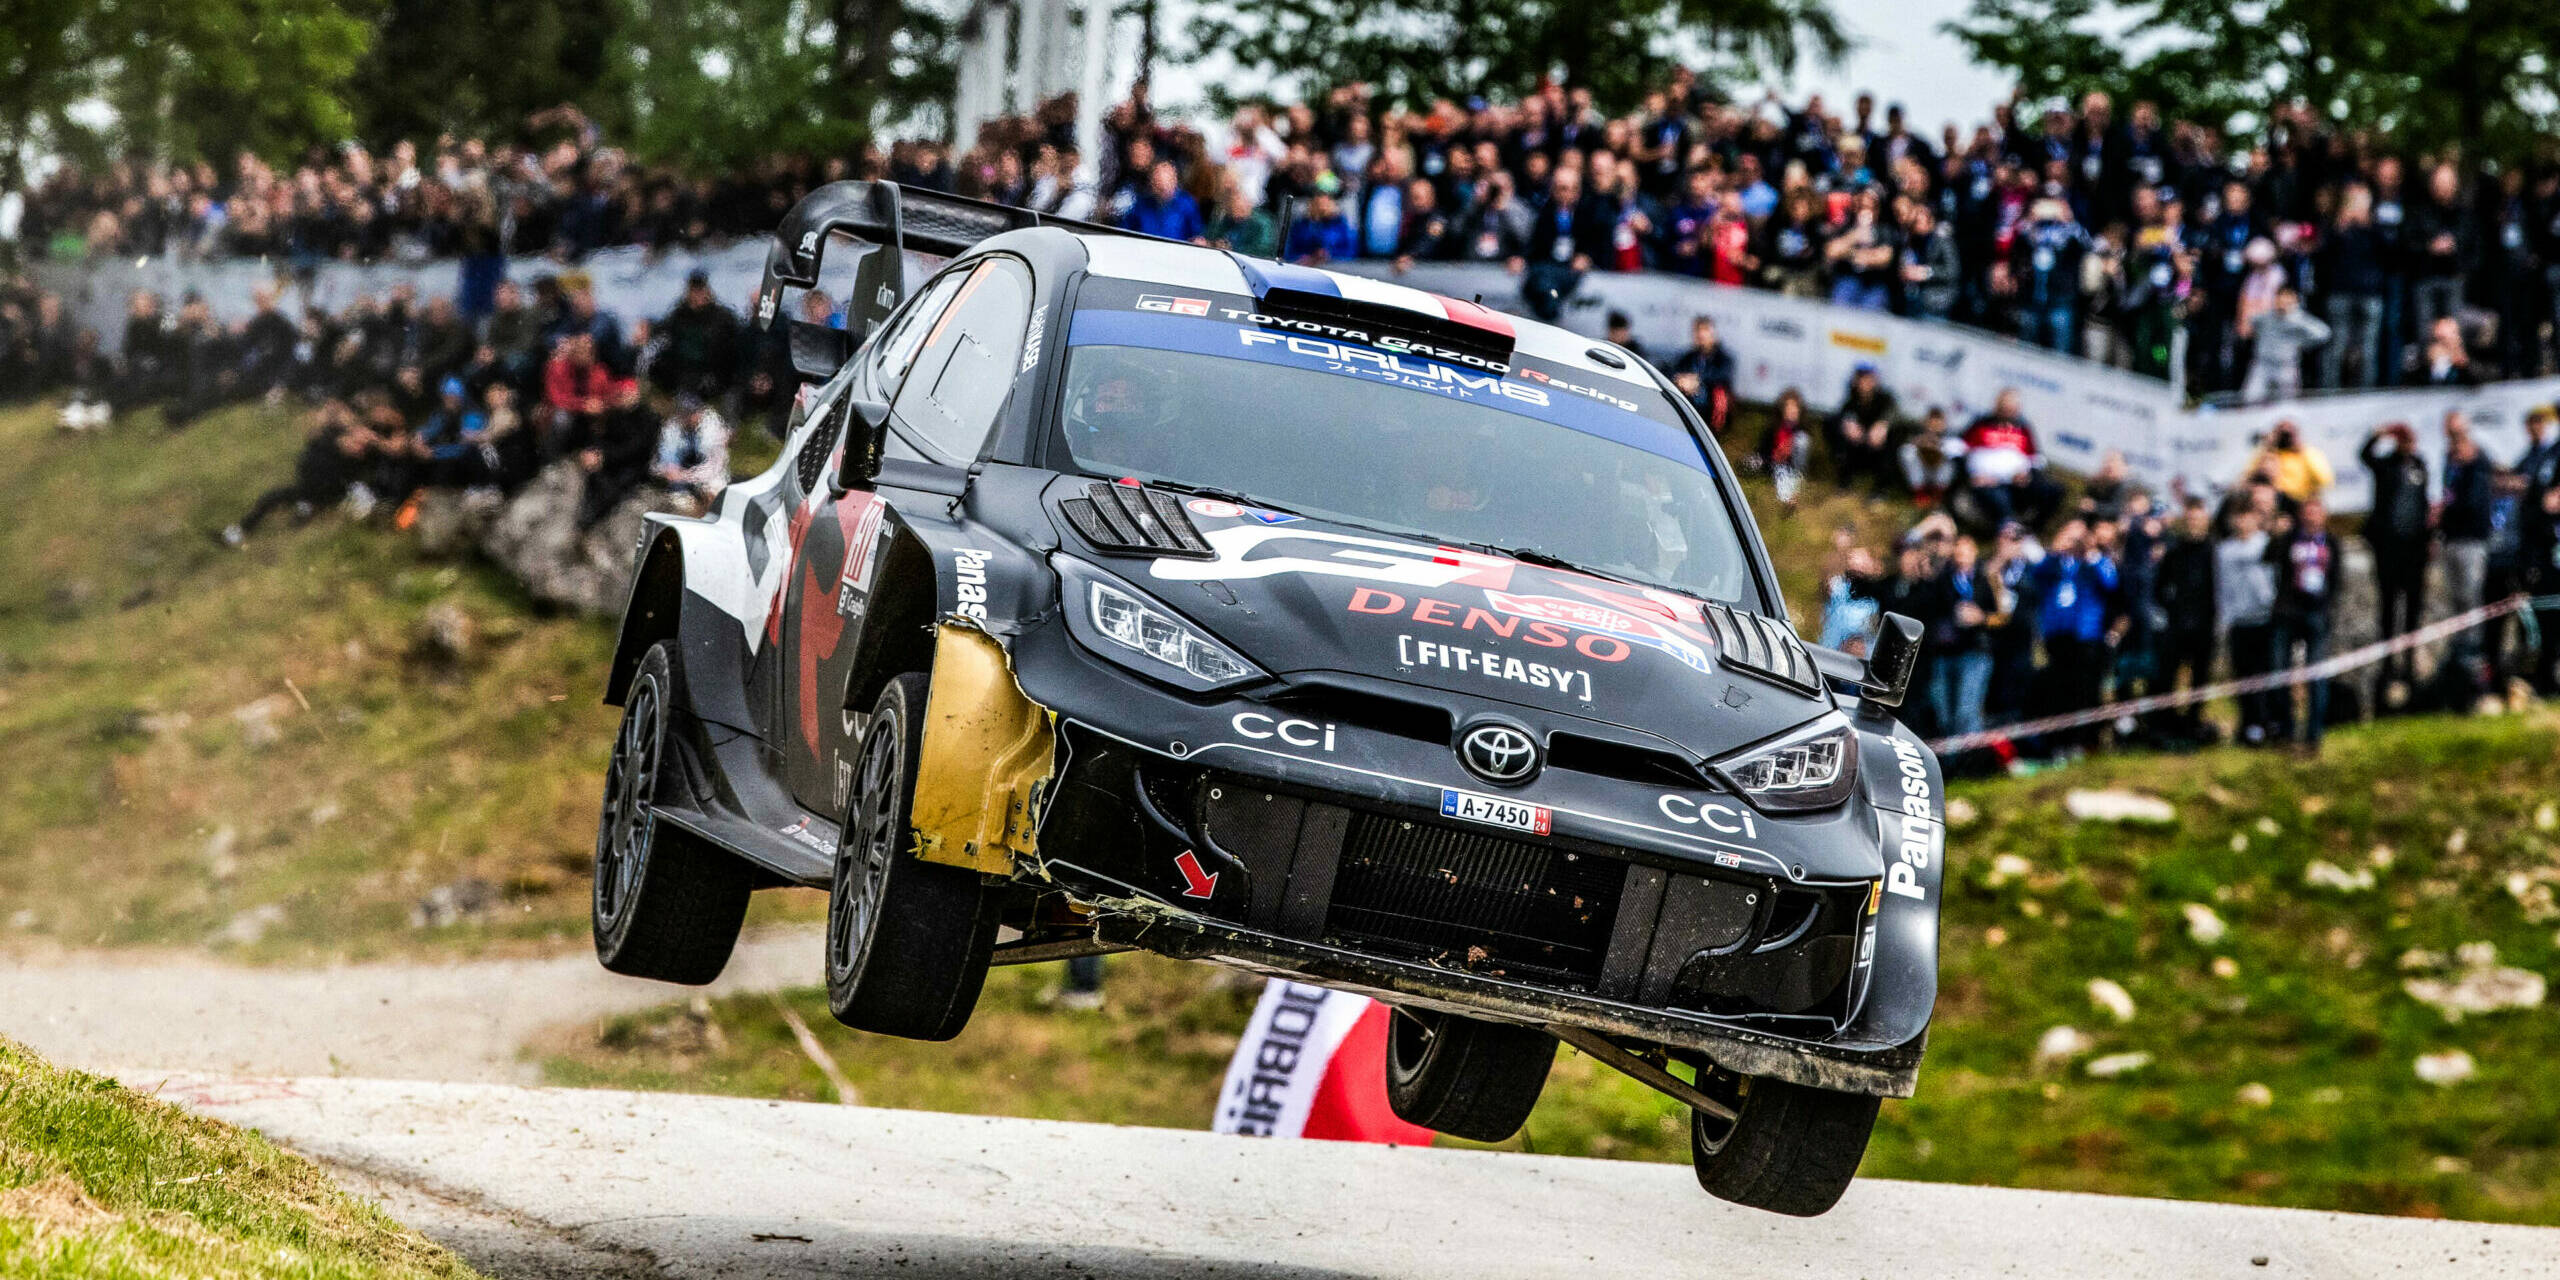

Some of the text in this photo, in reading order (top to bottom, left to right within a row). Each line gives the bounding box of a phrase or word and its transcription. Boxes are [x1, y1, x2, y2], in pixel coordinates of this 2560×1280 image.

[1139, 296, 1208, 316] GR
[1219, 307, 1639, 412] TOYOTA GAZOO Racing
[1239, 328, 1551, 407] FORUM8
[1325, 360, 1474, 398] フォーラムエイト
[1347, 586, 1632, 663] DENSO
[1445, 805, 1455, 813] FIN
[1462, 798, 1529, 826] A-7450
[1881, 735, 1931, 901] Panasonic
[1715, 852, 1741, 868] GR
